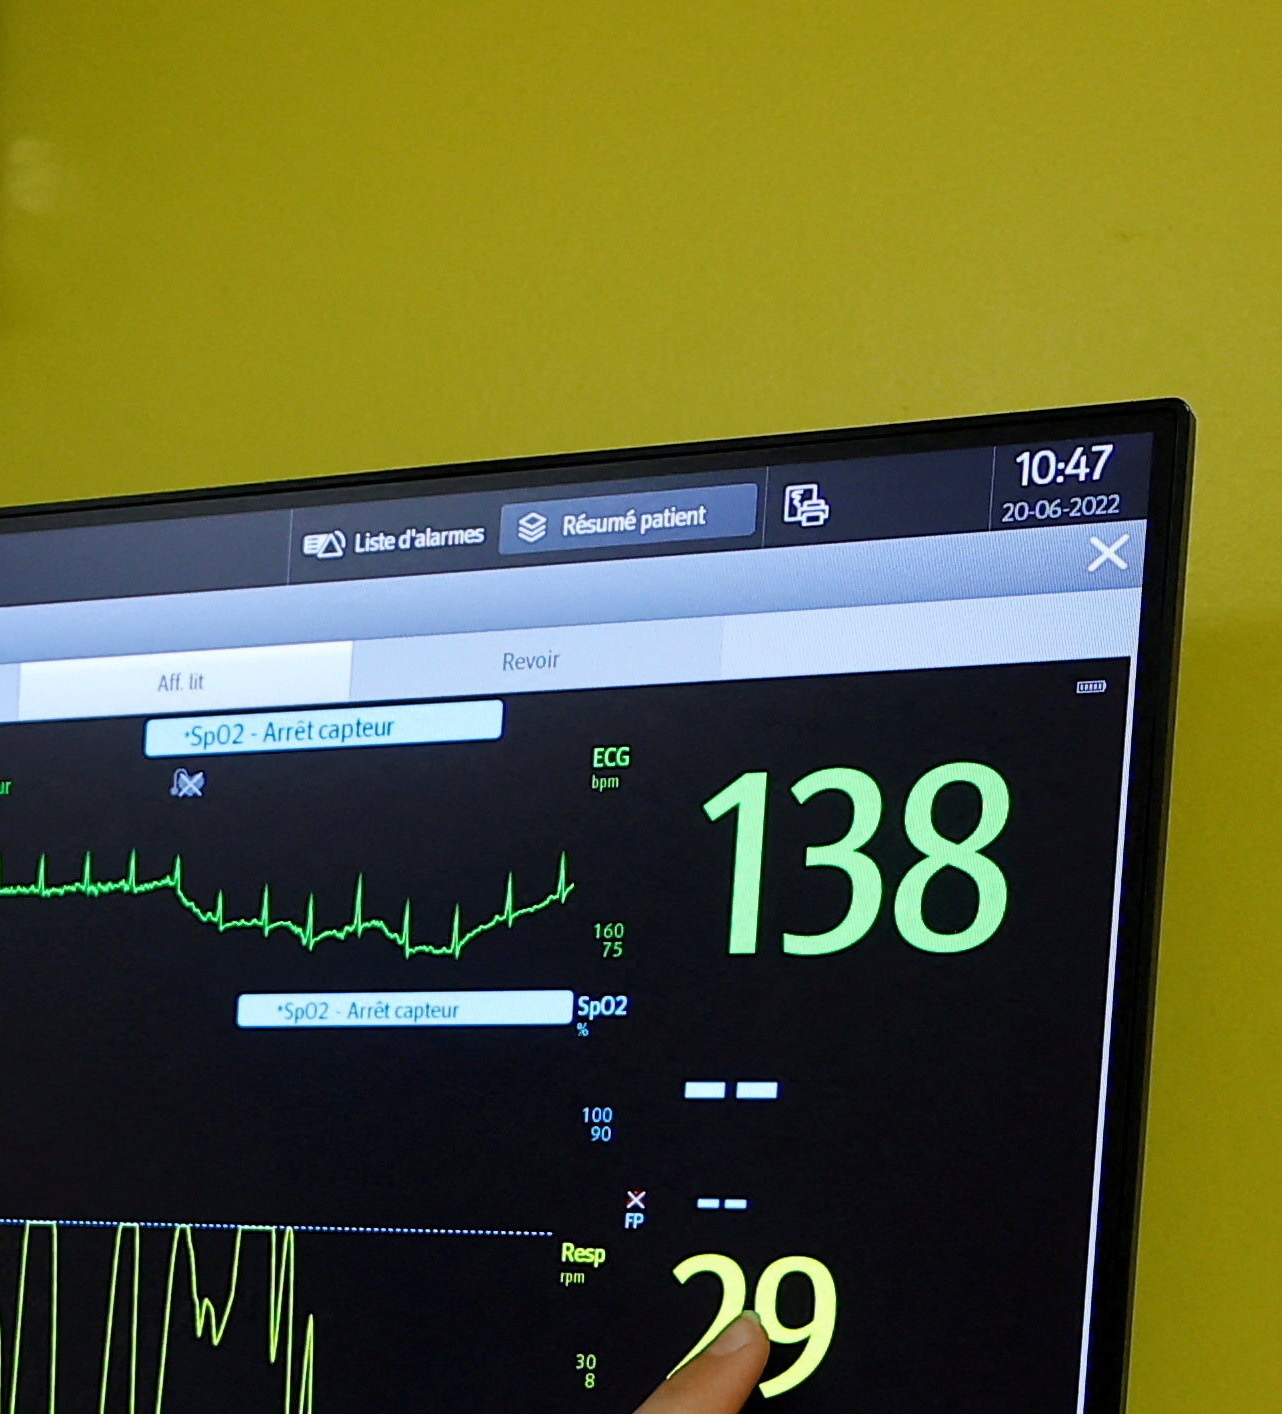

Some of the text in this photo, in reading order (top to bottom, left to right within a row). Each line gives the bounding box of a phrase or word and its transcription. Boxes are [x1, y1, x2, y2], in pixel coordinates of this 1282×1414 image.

[1015, 443, 1115, 487] 10:47
[1001, 494, 1121, 523] 20-06-2022
[562, 504, 707, 536] Résumé patient
[354, 526, 485, 554] Liste d'alarmes
[502, 651, 561, 672] Revoir
[157, 672, 204, 692] Aff. lit
[262, 718, 314, 744] Arrêt
[317, 718, 395, 745] capteur
[592, 746, 630, 768] ECG
[591, 774, 619, 792] bpm
[703, 760, 1011, 957] 138
[594, 922, 624, 940] 160
[602, 941, 623, 959] 75
[345, 1000, 391, 1020] Arrêt
[394, 1002, 460, 1025] capteur
[577, 995, 629, 1020] SpO2
[576, 1022, 589, 1037] %
[582, 1107, 613, 1124] 100
[590, 1125, 612, 1142] 90
[624, 1212, 645, 1230] FP
[561, 1242, 606, 1268] Resp
[560, 1270, 585, 1286] rpm
[667, 1252, 837, 1399] 29
[575, 1353, 597, 1371] 30
[584, 1373, 596, 1389] 8
